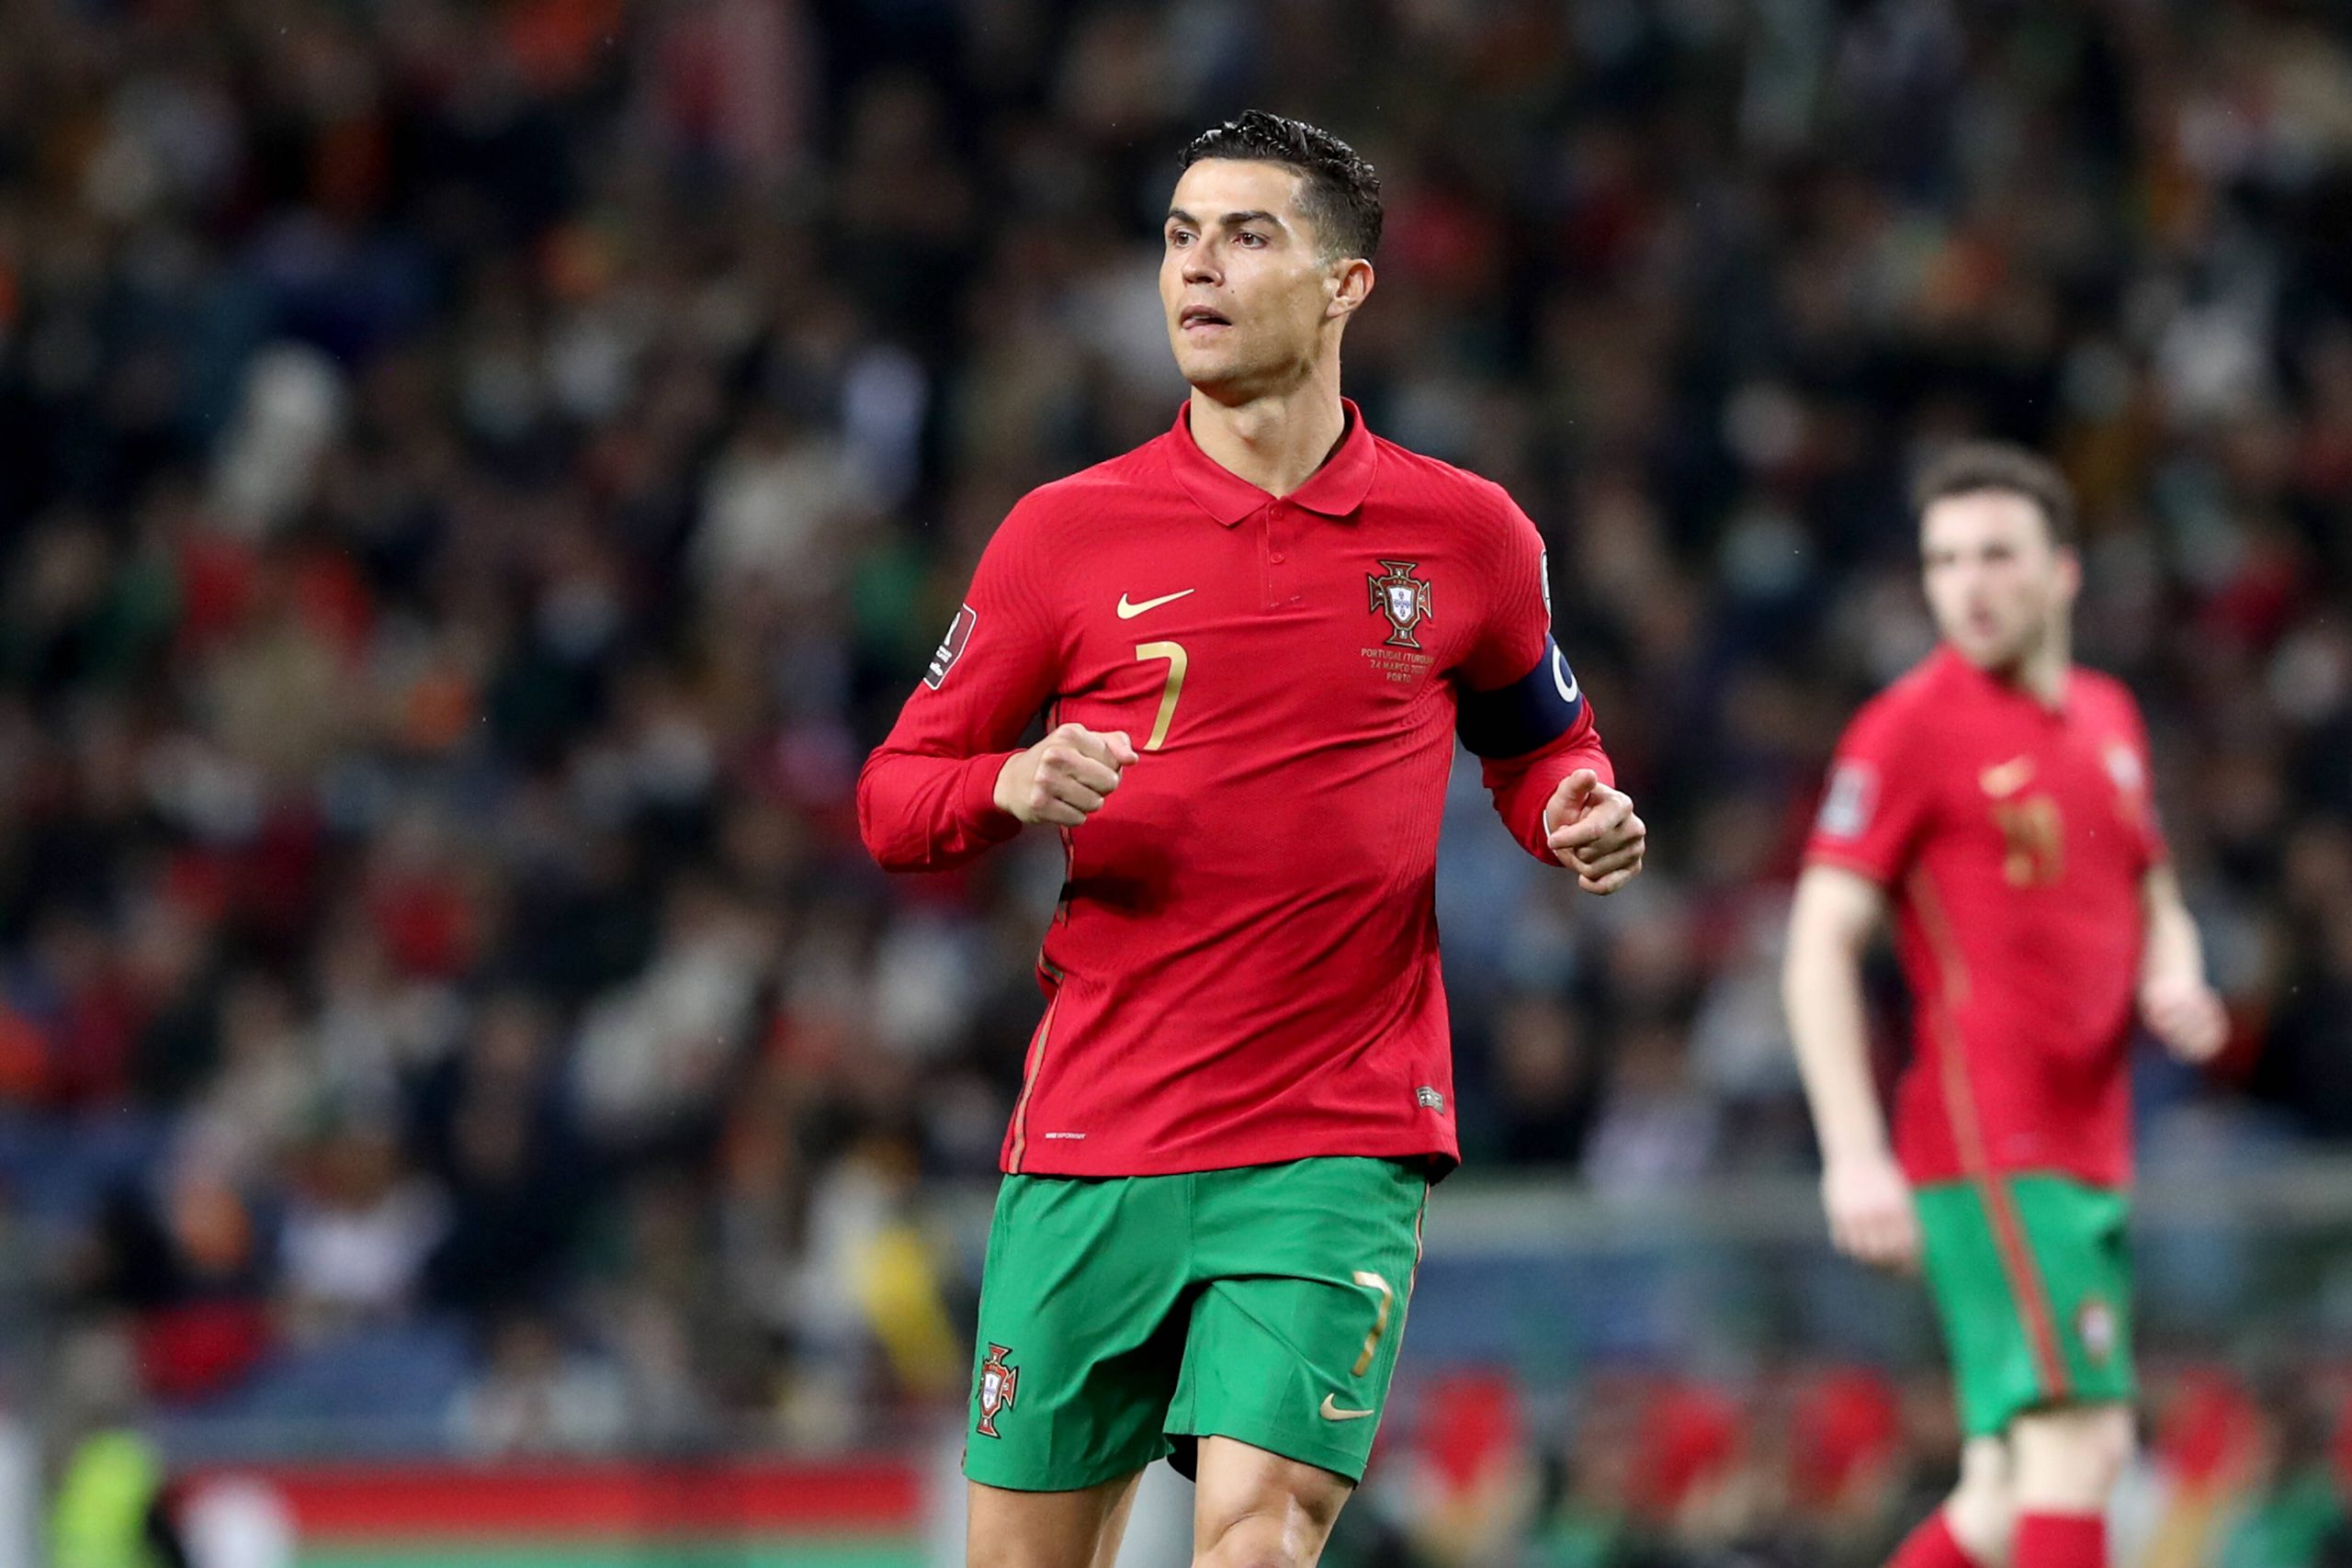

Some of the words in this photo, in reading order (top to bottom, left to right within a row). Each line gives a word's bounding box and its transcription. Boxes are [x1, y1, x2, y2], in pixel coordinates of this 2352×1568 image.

[1135, 640, 1188, 751] 7
[1386, 671, 1412, 682] PORTO
[1351, 1270, 1392, 1377] 7
